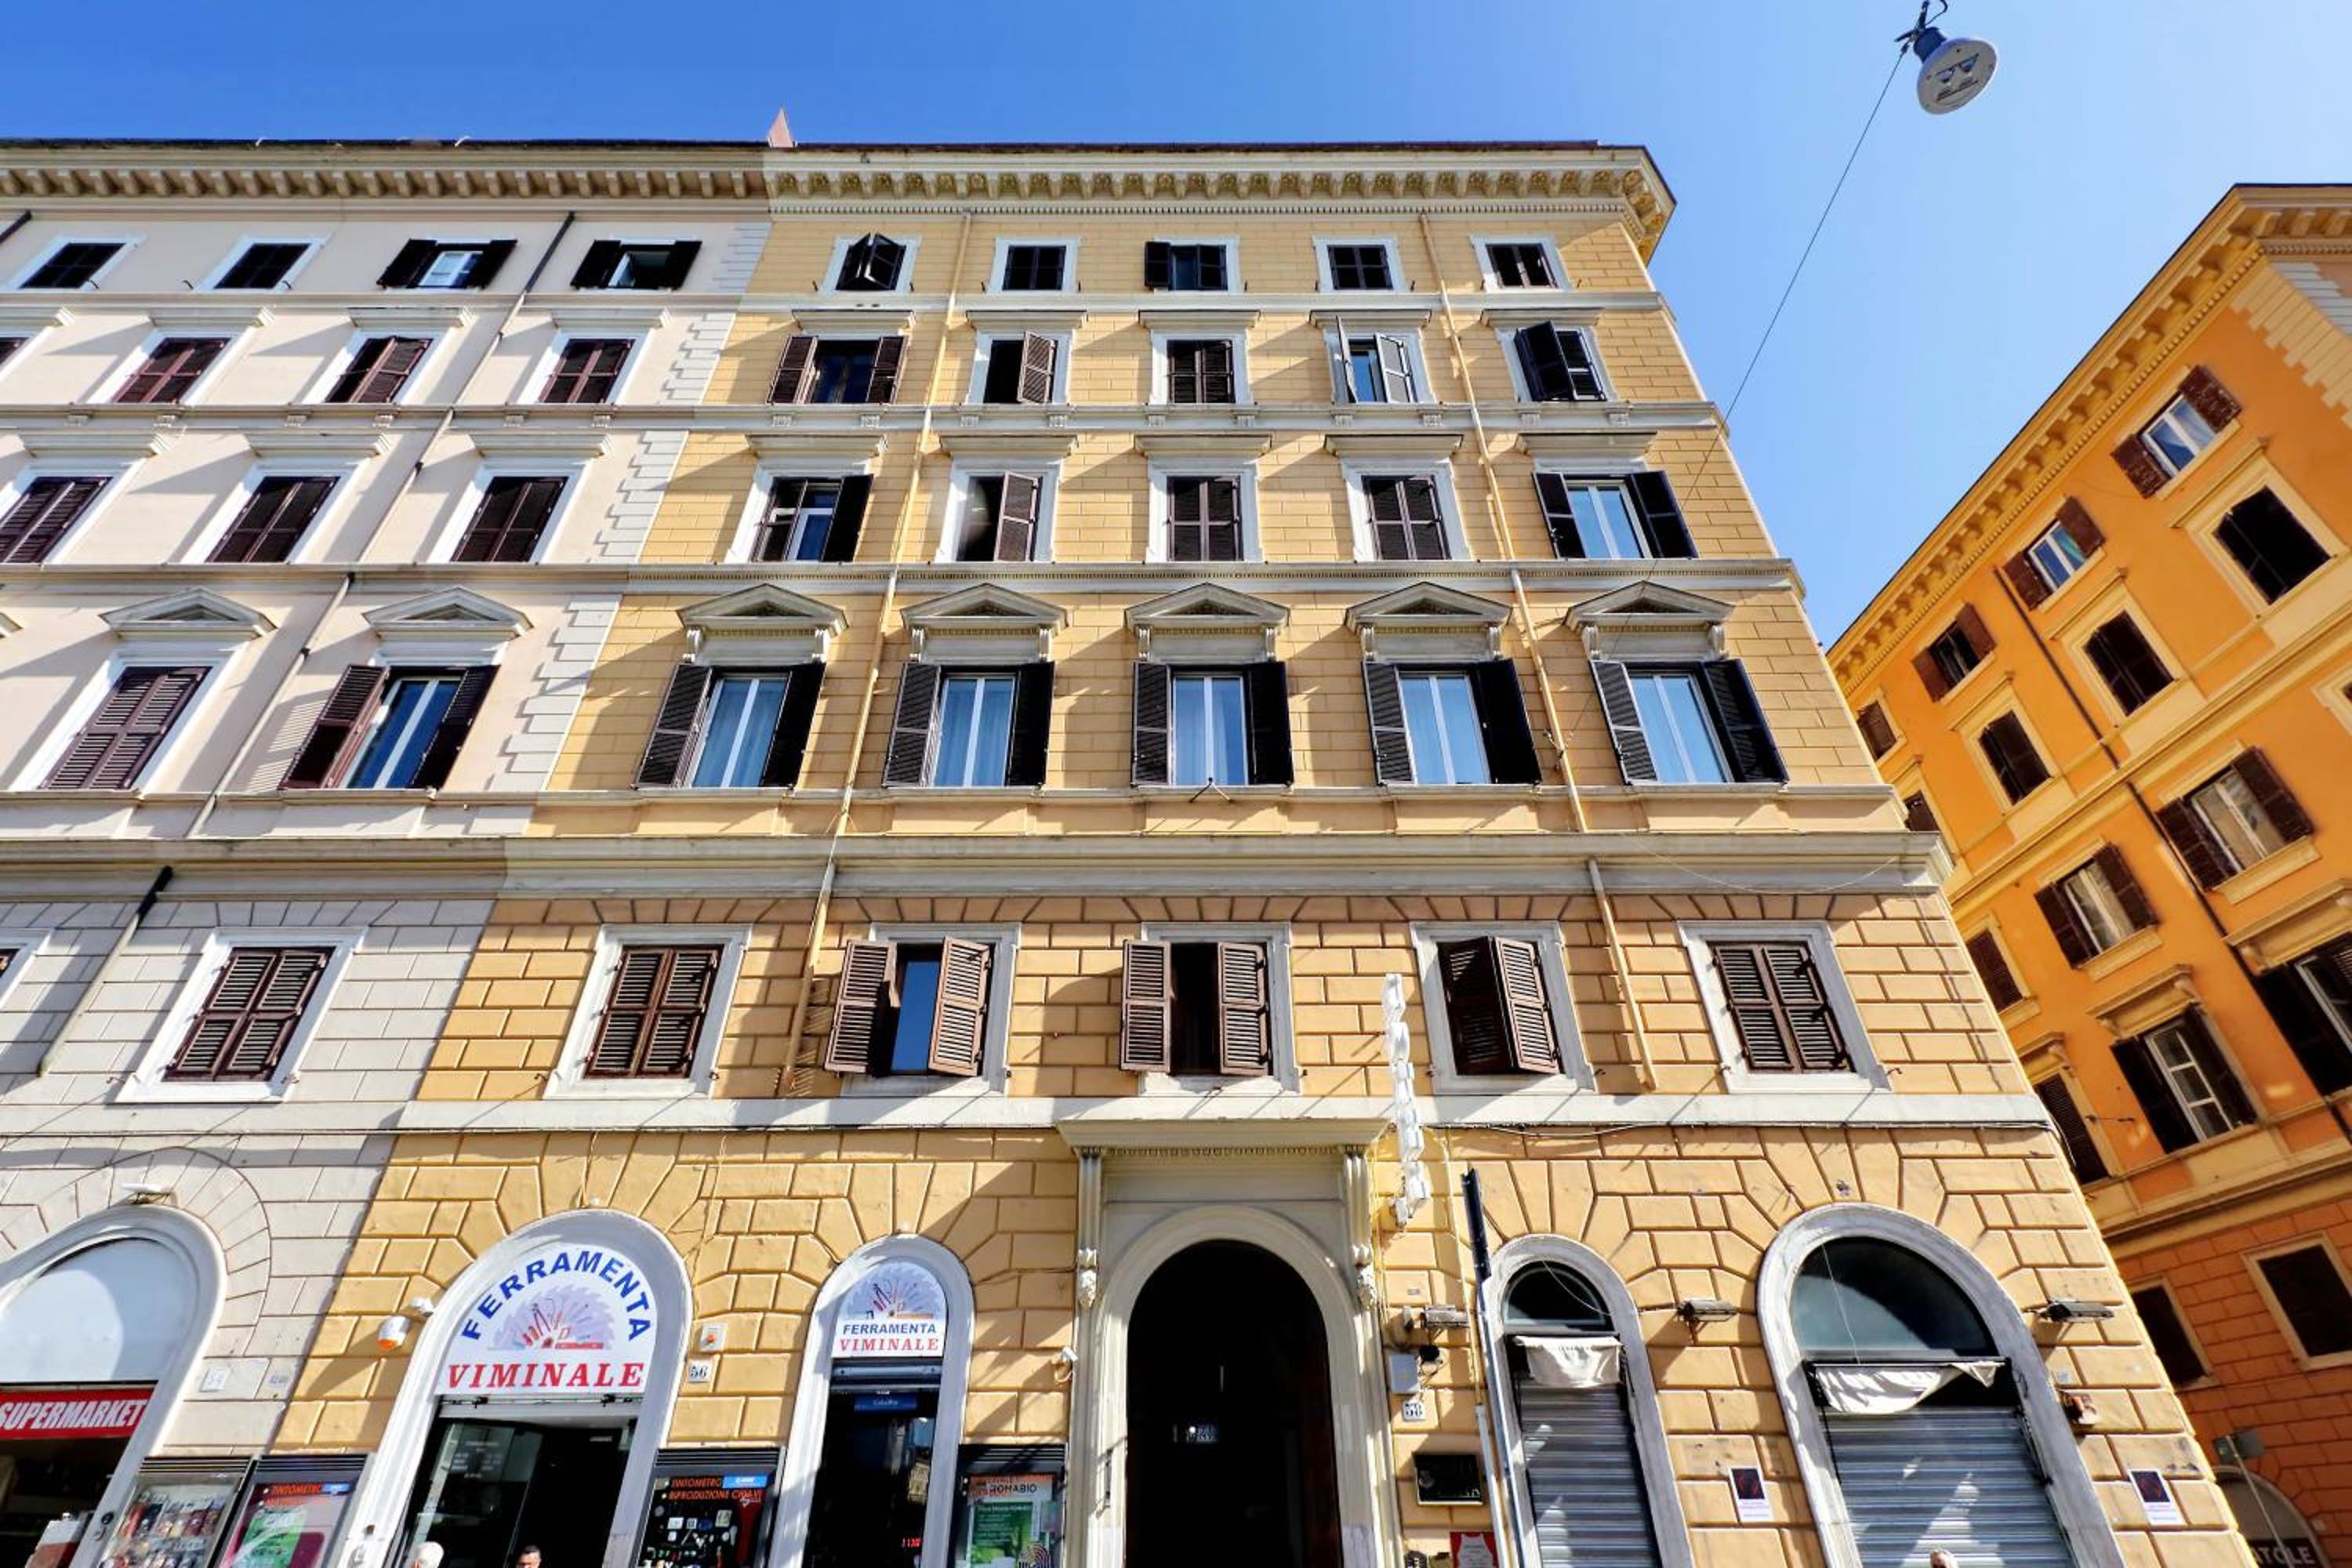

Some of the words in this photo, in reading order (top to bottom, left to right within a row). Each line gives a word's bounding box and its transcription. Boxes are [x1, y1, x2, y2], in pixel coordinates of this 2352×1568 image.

[461, 1250, 652, 1341] FERRAMENTA
[843, 1323, 937, 1335] FERRAMENTA
[840, 1338, 939, 1351] VIMINALE
[448, 1362, 645, 1388] VIMINALE
[0, 1399, 149, 1431] SUPERMARKET
